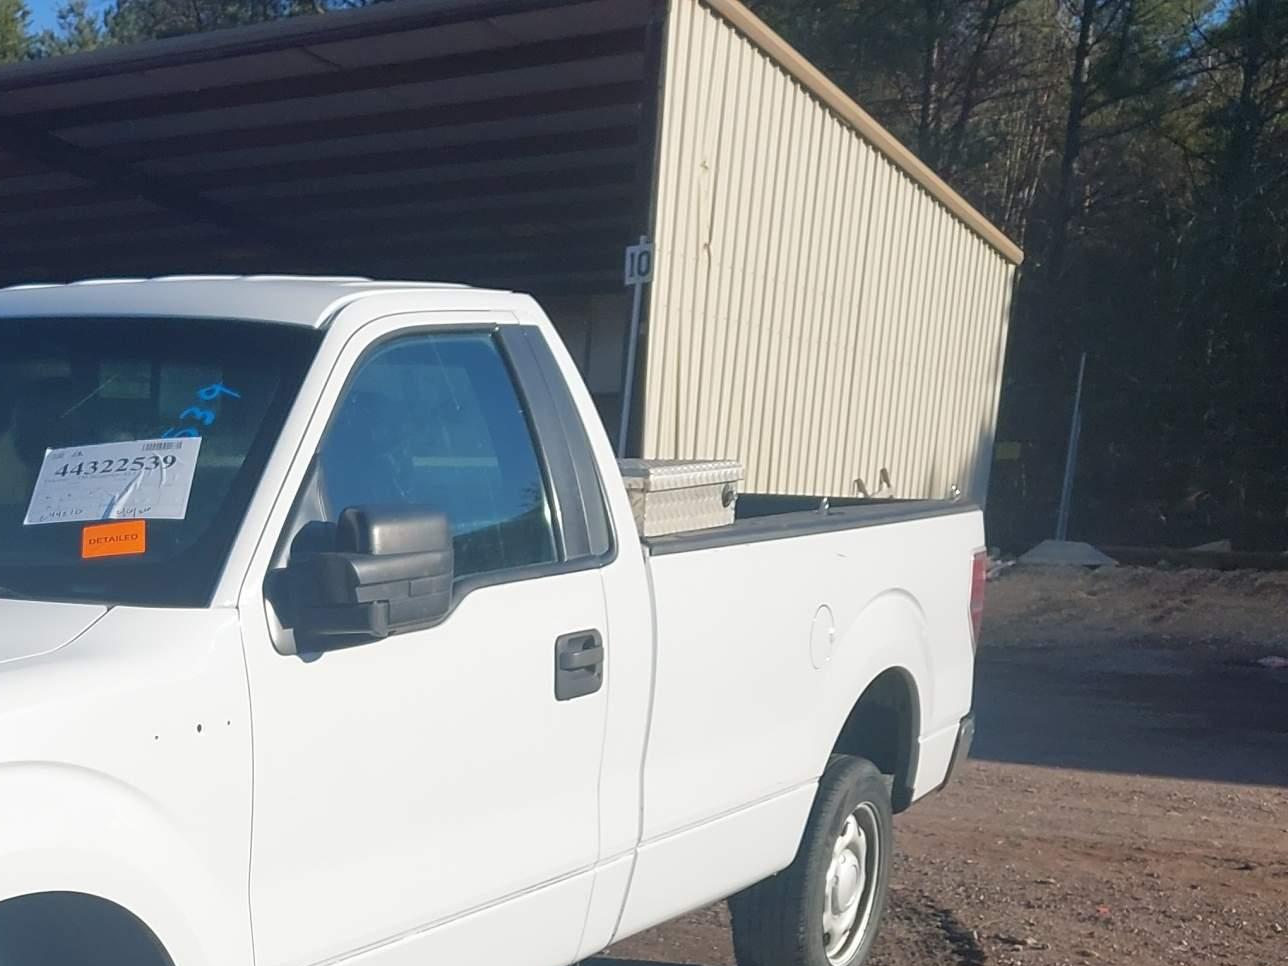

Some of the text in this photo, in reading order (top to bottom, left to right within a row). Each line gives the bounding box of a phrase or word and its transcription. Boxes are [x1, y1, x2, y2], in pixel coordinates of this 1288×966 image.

[630, 250, 650, 277] 10
[54, 454, 178, 478] 44322539
[88, 533, 139, 545] DETAILED
